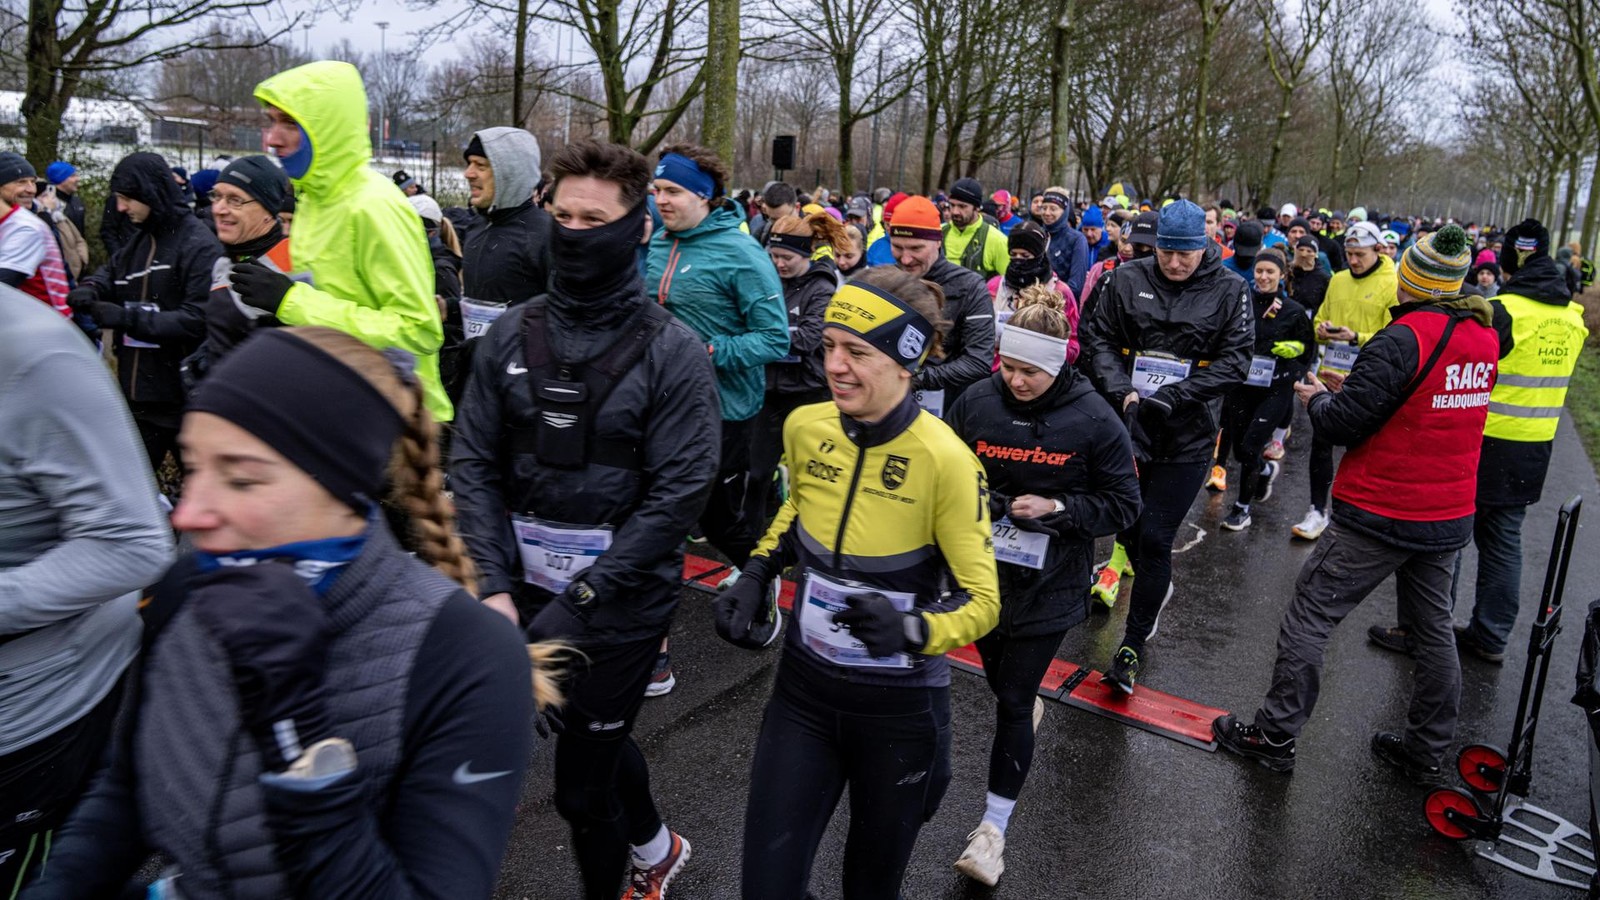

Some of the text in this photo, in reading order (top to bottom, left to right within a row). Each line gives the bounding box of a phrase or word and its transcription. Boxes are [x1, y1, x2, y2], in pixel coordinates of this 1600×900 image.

[1138, 291, 1154, 300] JAKO
[1538, 347, 1569, 357] HADI
[1146, 373, 1167, 385] 727
[1445, 362, 1494, 391] RACE
[976, 440, 1073, 466] Powerbar
[993, 524, 1019, 541] 272
